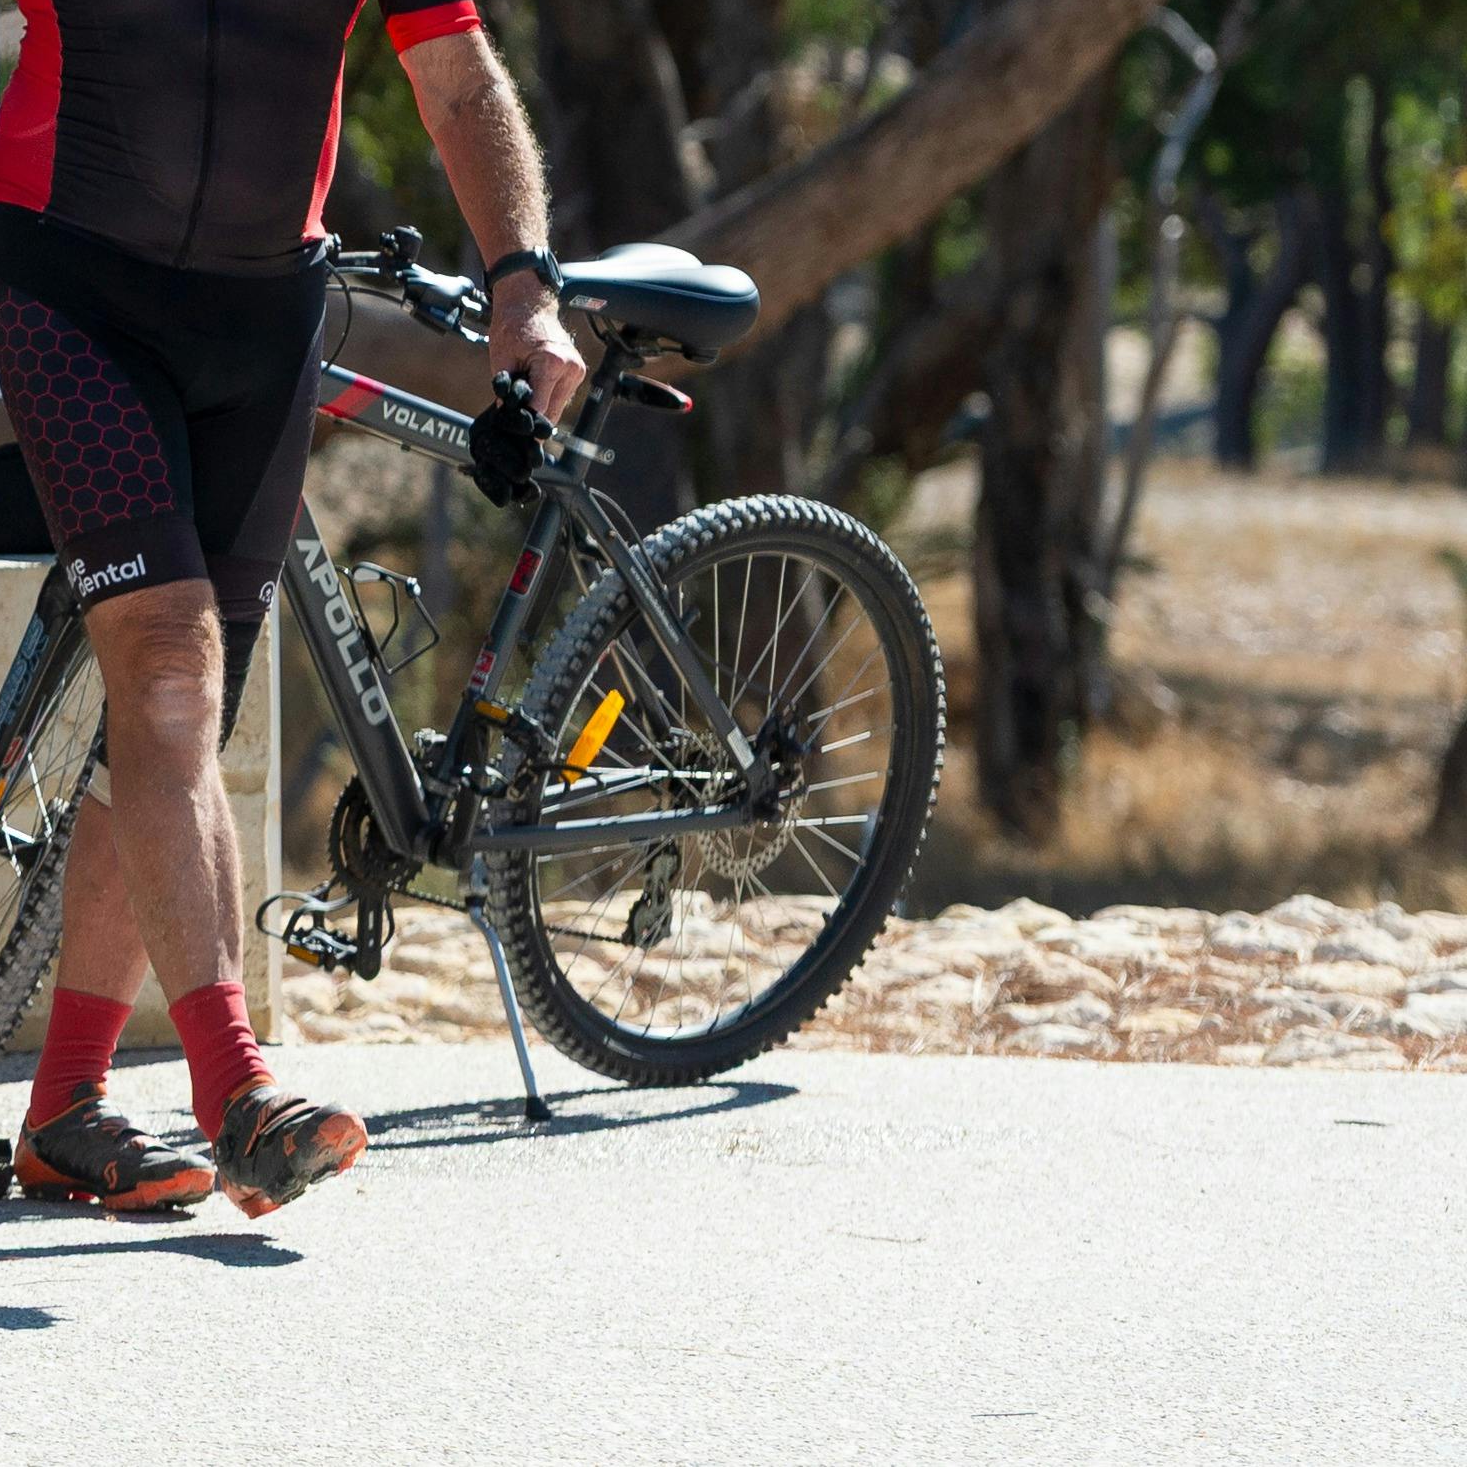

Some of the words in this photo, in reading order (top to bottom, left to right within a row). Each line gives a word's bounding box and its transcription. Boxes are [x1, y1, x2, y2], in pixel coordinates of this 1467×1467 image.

[380, 400, 469, 446] VOLATIL
[77, 552, 147, 598] dental
[295, 538, 388, 727] APOLLO
